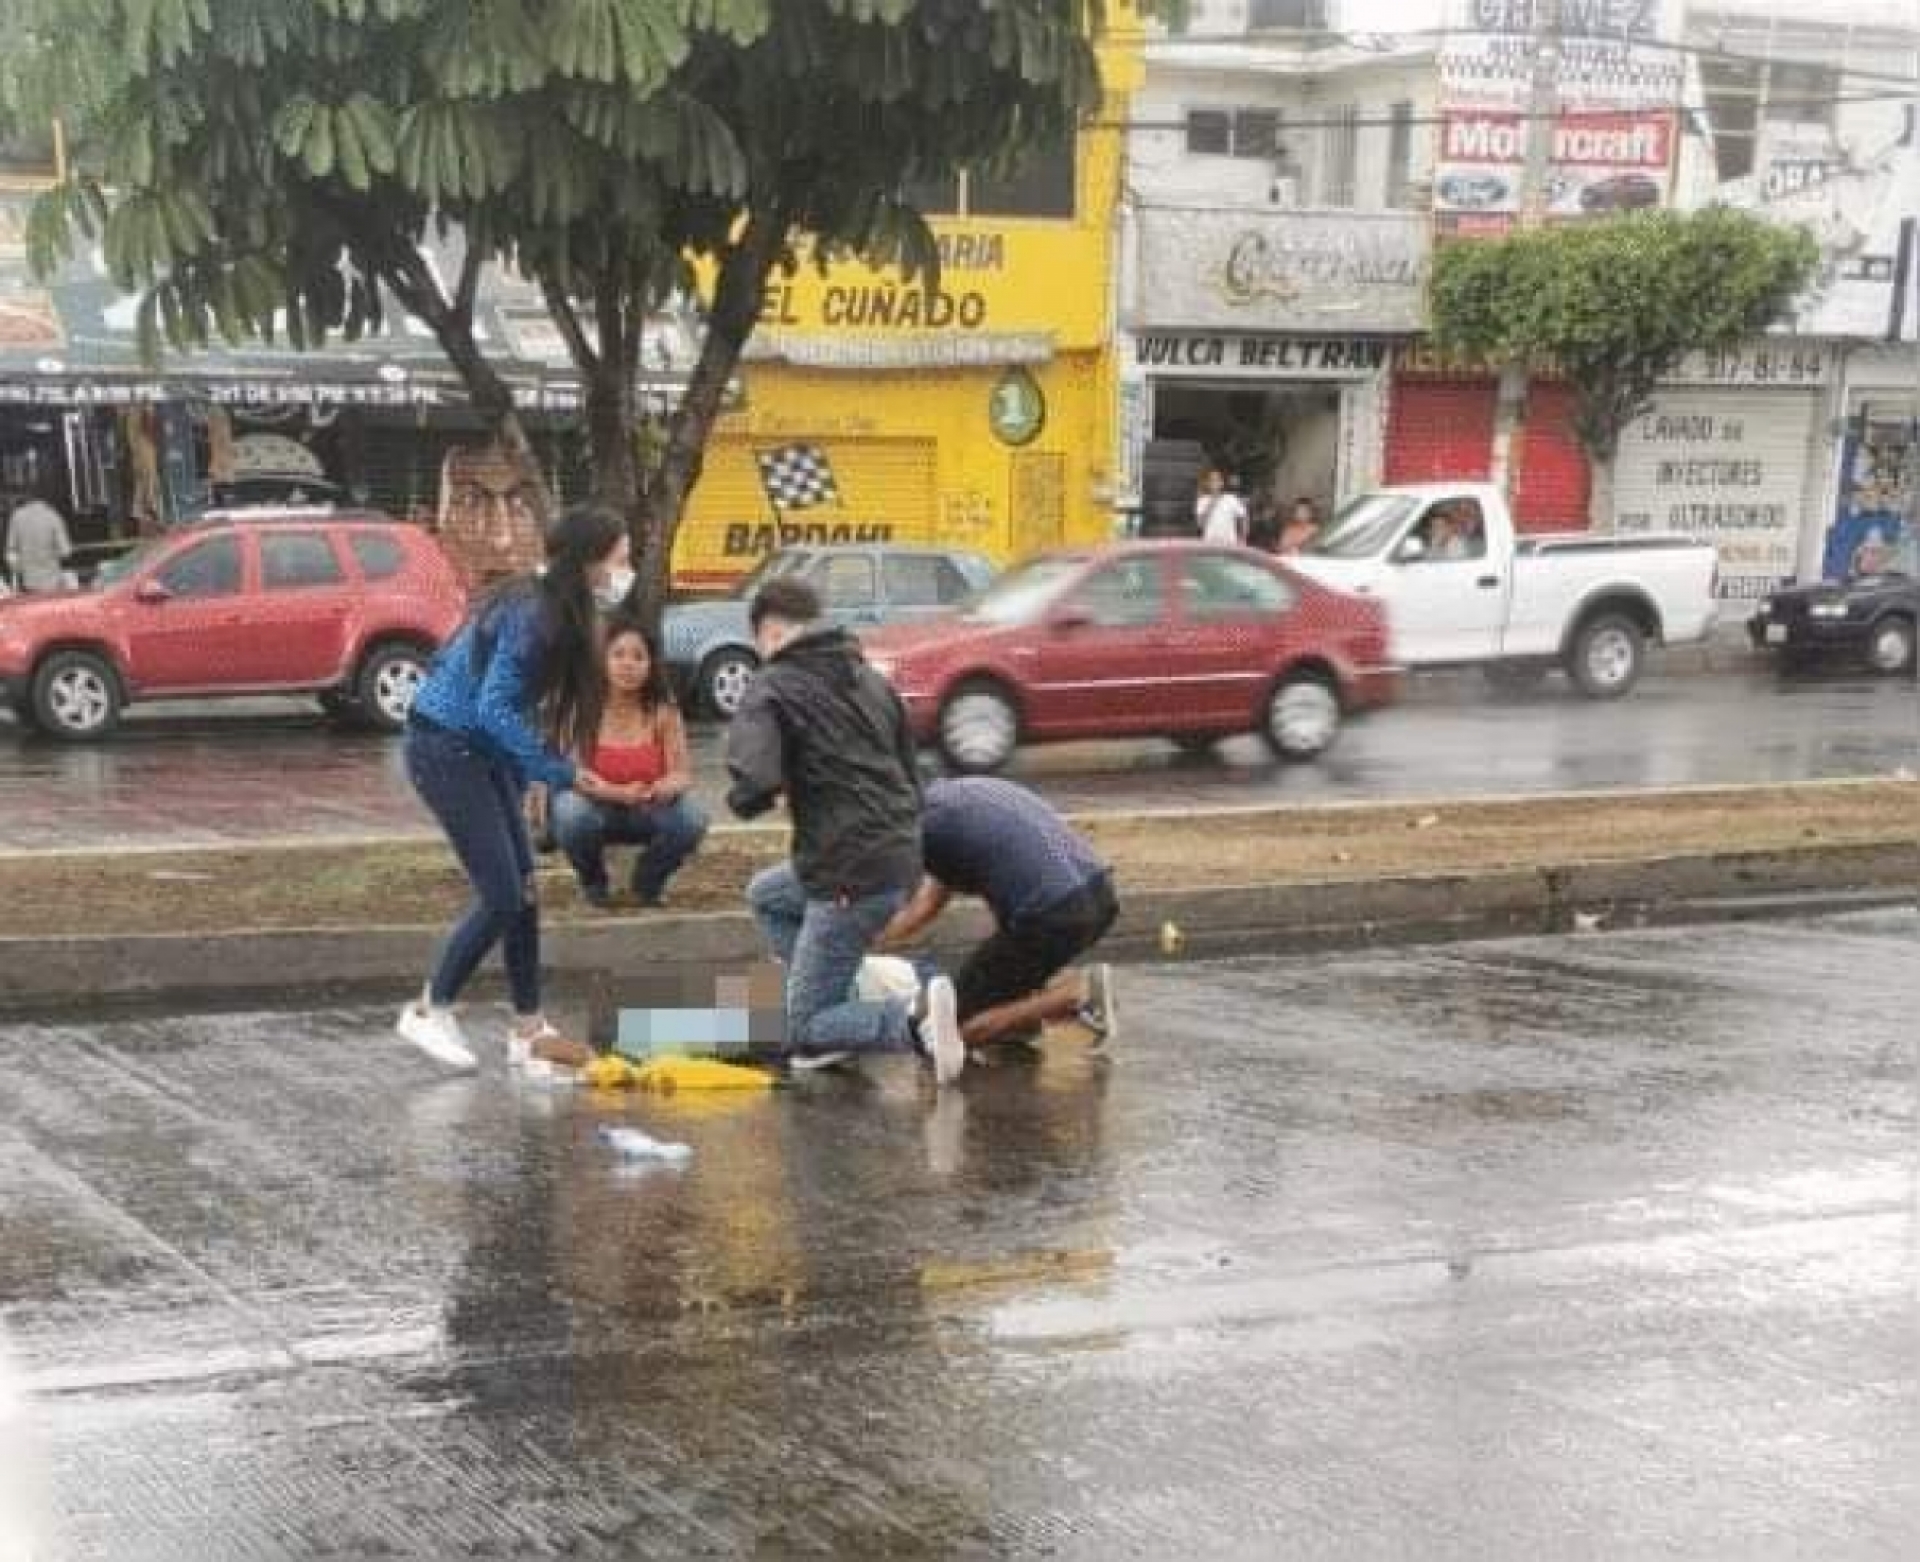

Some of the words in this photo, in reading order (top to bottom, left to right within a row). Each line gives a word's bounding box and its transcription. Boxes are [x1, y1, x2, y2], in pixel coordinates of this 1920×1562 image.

[1448, 120, 1660, 161] Morcraft
[823, 280, 987, 329] CUÑADO
[1240, 338, 1385, 370] BELTRAN
